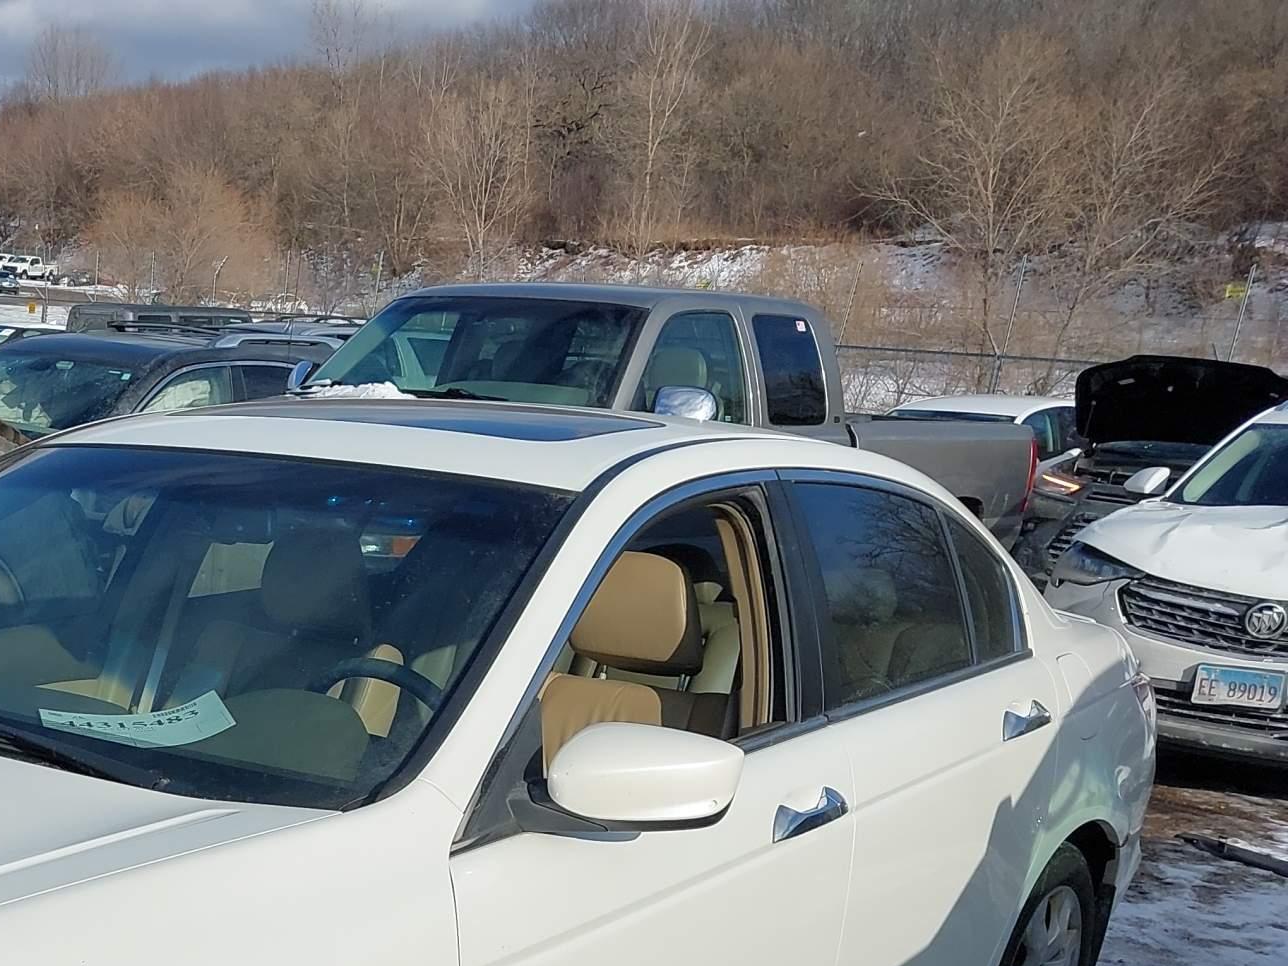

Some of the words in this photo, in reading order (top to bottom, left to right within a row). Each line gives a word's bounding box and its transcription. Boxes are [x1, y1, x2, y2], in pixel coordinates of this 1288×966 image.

[1198, 678, 1218, 697] EE
[1226, 680, 1278, 704] 89019
[61, 709, 200, 730] 44315483
